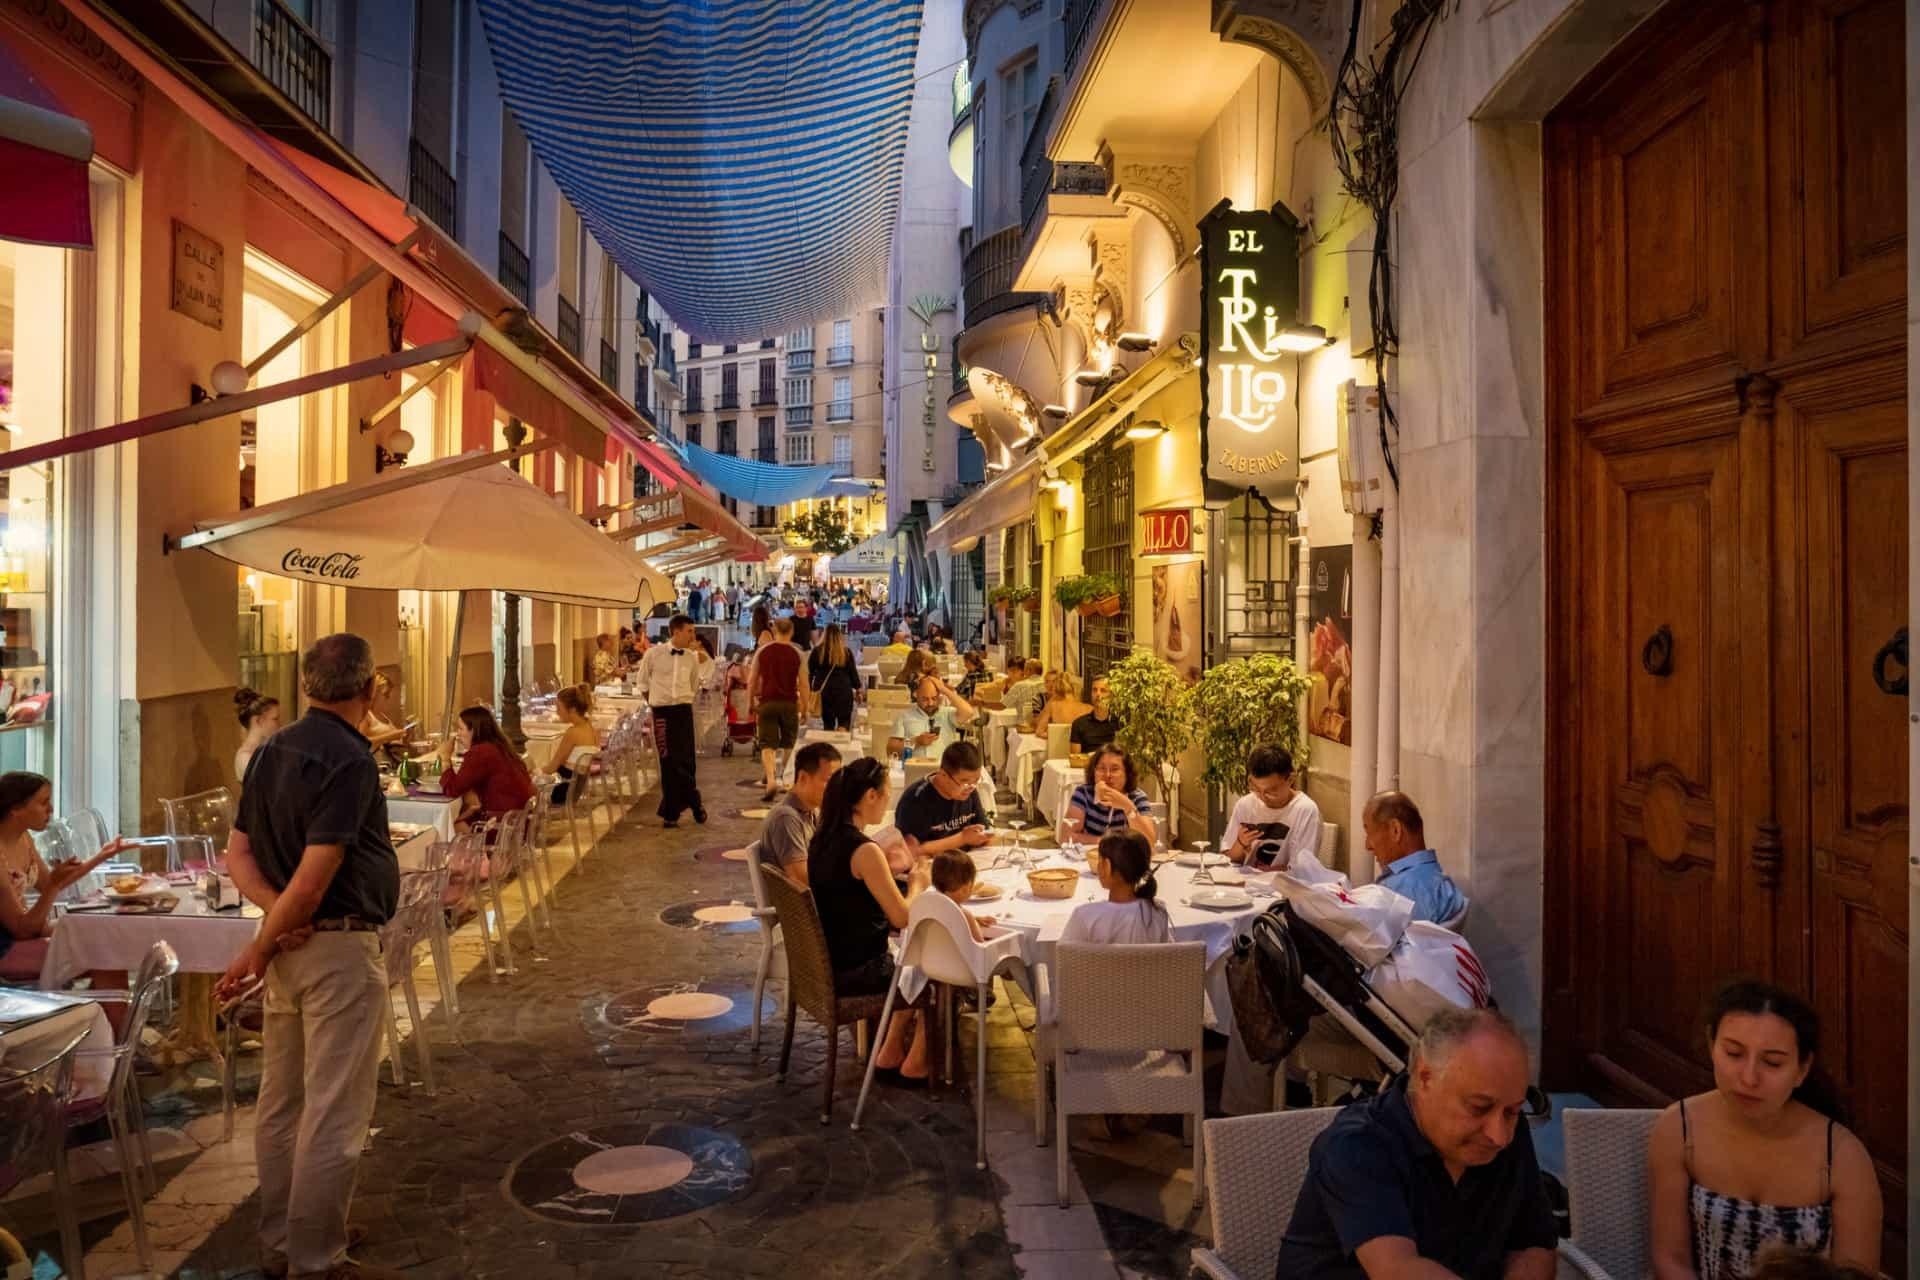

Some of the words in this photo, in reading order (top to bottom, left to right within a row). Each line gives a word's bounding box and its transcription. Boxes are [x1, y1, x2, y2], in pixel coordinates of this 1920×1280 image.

[1228, 229, 1264, 253] EL
[184, 241, 217, 271] CALLE
[1219, 448, 1288, 475] TABERNA
[281, 547, 366, 580] Coca-Cola
